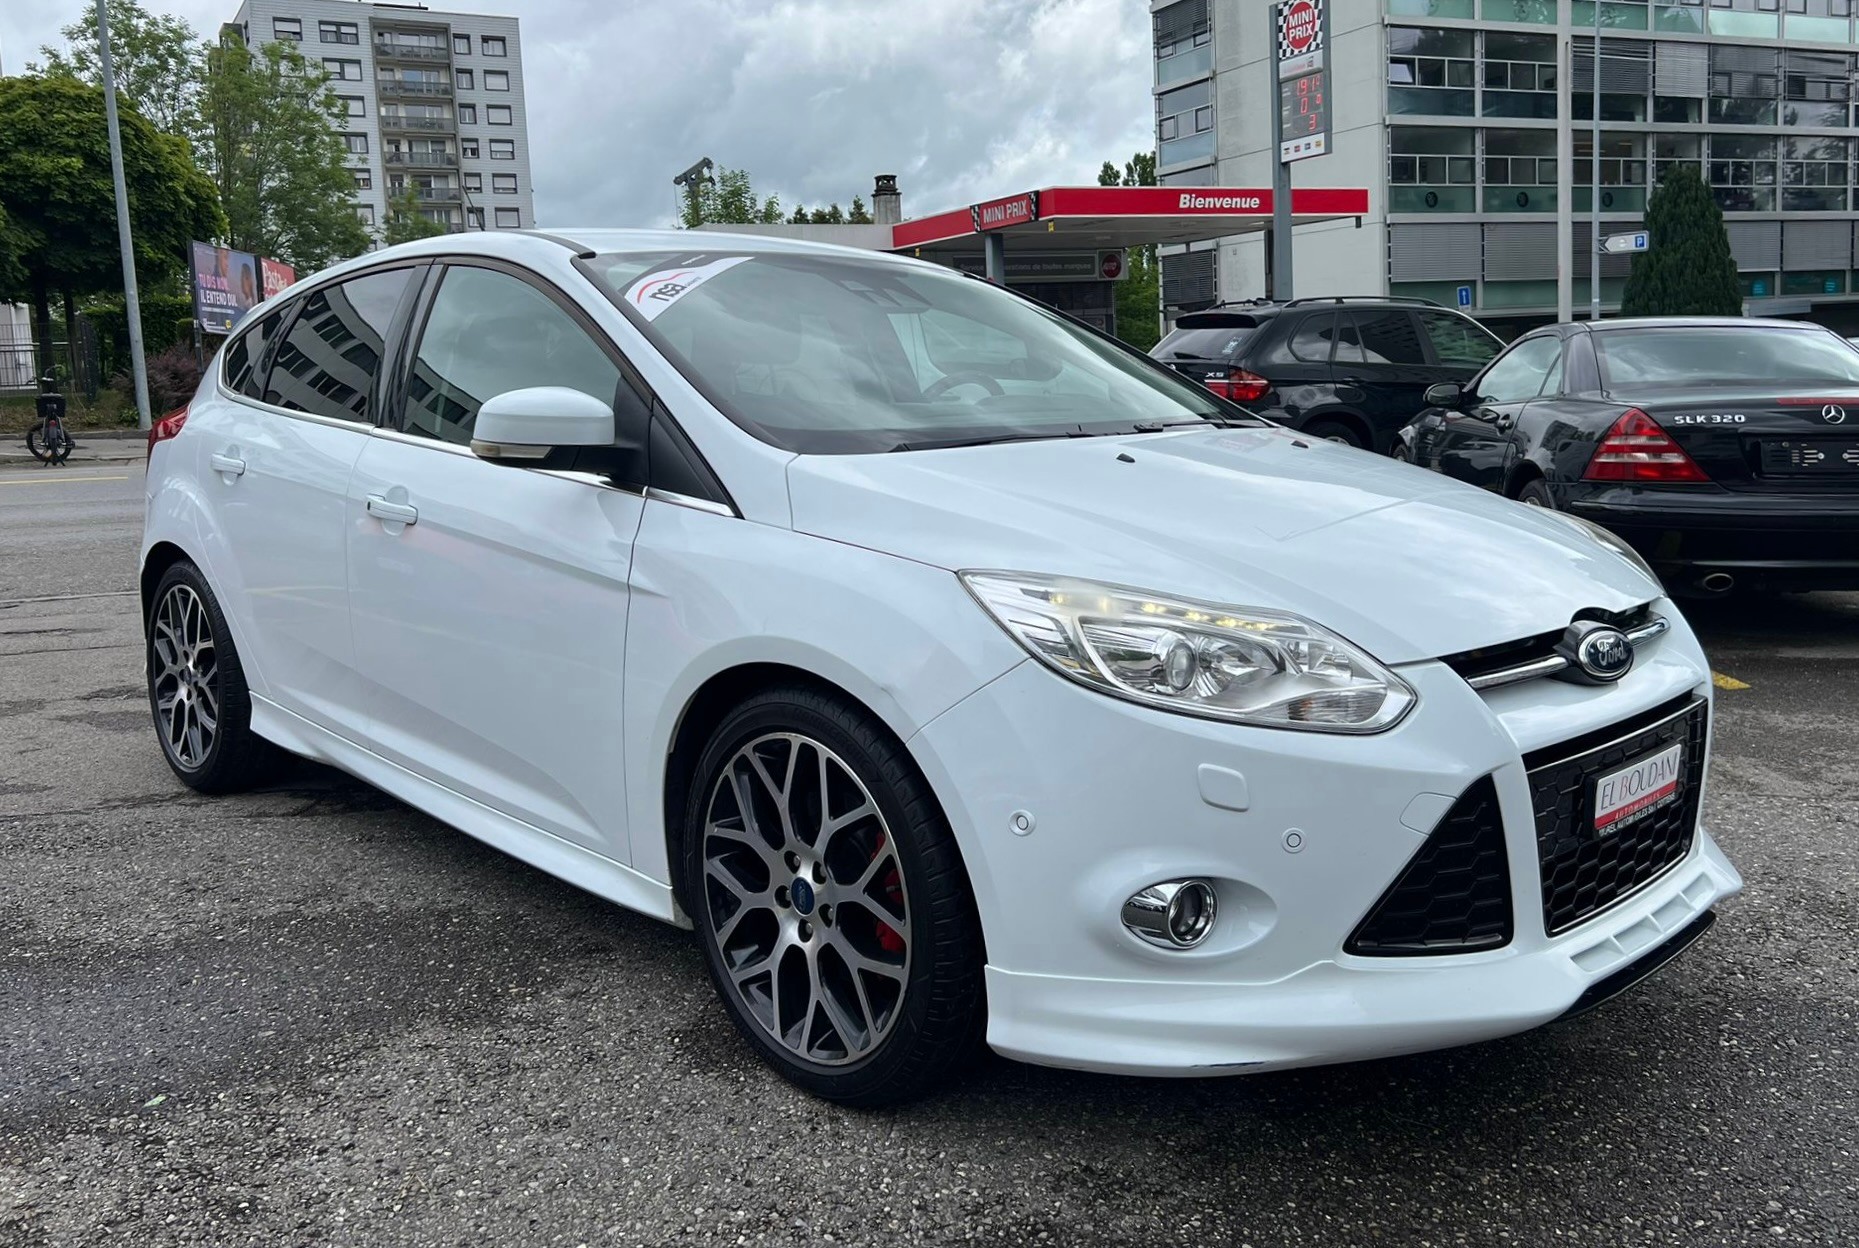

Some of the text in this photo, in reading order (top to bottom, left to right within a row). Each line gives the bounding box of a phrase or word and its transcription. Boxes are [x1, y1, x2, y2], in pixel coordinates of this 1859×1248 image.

[1289, 8, 1313, 29] MINI
[1289, 22, 1313, 42] PRIX
[1179, 193, 1260, 209] Bienvenue
[983, 200, 1027, 224] MINI PRIX
[198, 273, 207, 288] TU
[207, 275, 216, 289] DIS
[200, 289, 206, 304] IL
[206, 290, 227, 306] ENTEND
[1674, 414, 1746, 424] SLK 320
[1597, 637, 1626, 666] Ford
[1600, 781, 1616, 811] EL
